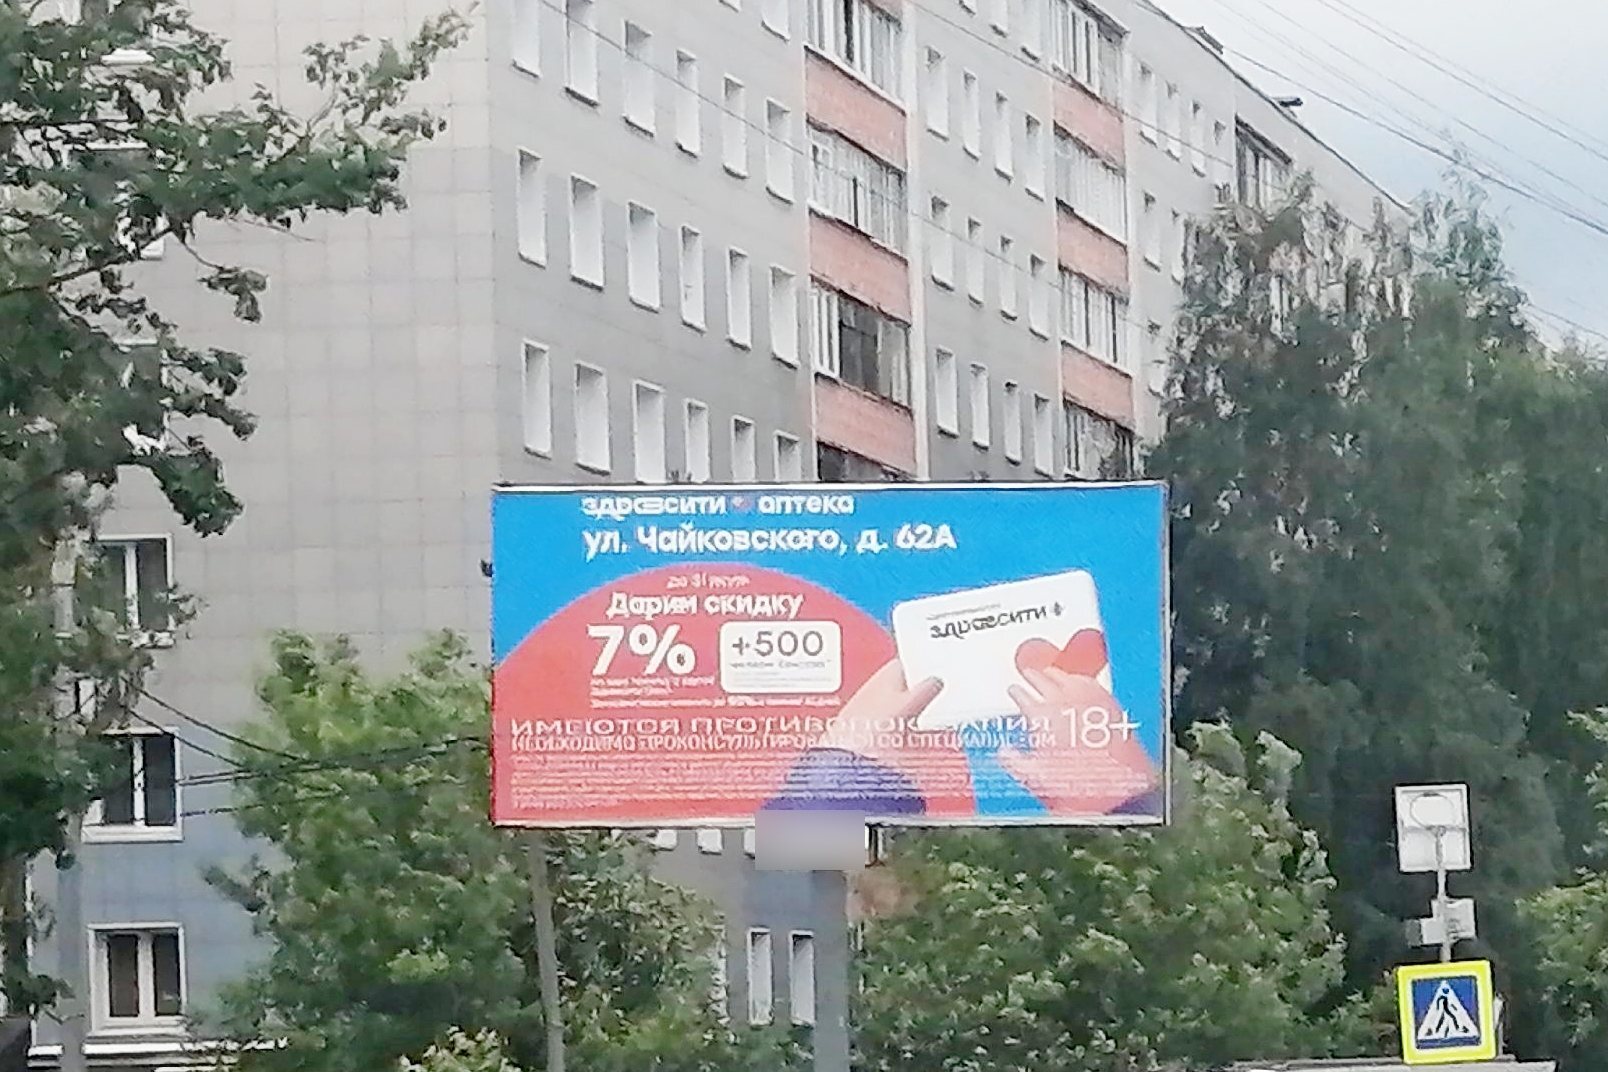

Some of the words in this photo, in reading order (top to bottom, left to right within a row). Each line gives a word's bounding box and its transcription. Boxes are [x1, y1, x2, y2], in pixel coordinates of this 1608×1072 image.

[758, 495, 856, 515] аптека
[582, 529, 631, 562] ул.
[637, 520, 848, 556] Чайковского,
[856, 529, 889, 553] д.
[606, 592, 698, 620] Дарим
[703, 594, 804, 621] скидку
[587, 622, 696, 677] 7%
[731, 630, 824, 657] +500
[1062, 704, 1142, 750] 18+
